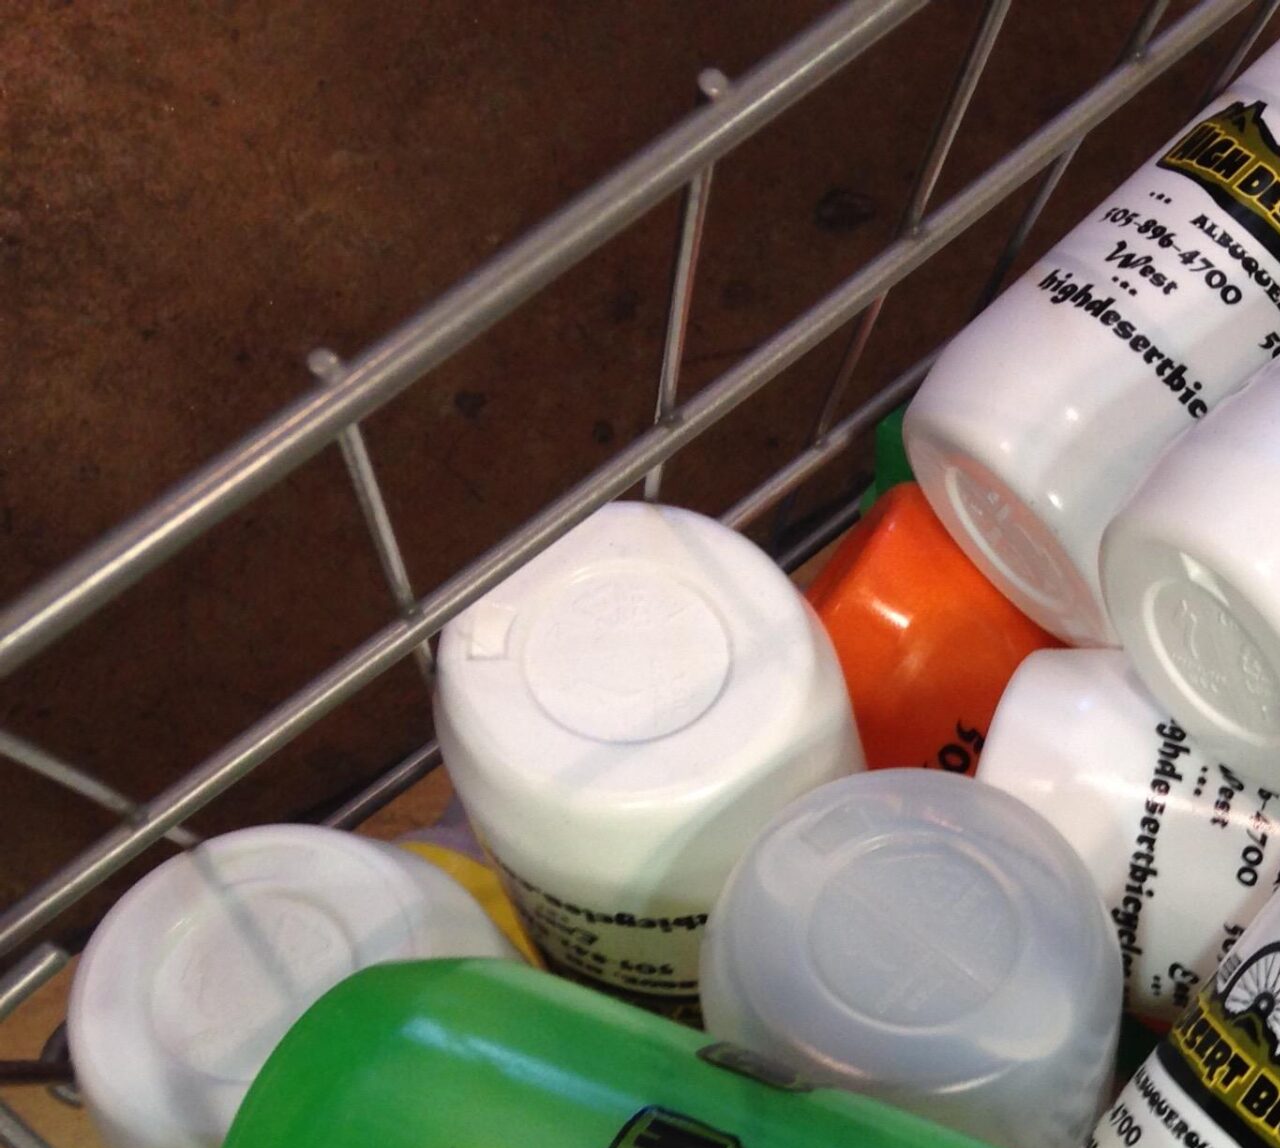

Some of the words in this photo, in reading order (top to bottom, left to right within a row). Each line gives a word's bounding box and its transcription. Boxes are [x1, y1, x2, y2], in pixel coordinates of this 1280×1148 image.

[1165, 122, 1249, 187] HIGH
[1103, 206, 1243, 306] 505-896-4700
[1104, 240, 1179, 295] West
[1037, 268, 1208, 420] highdesertbic
